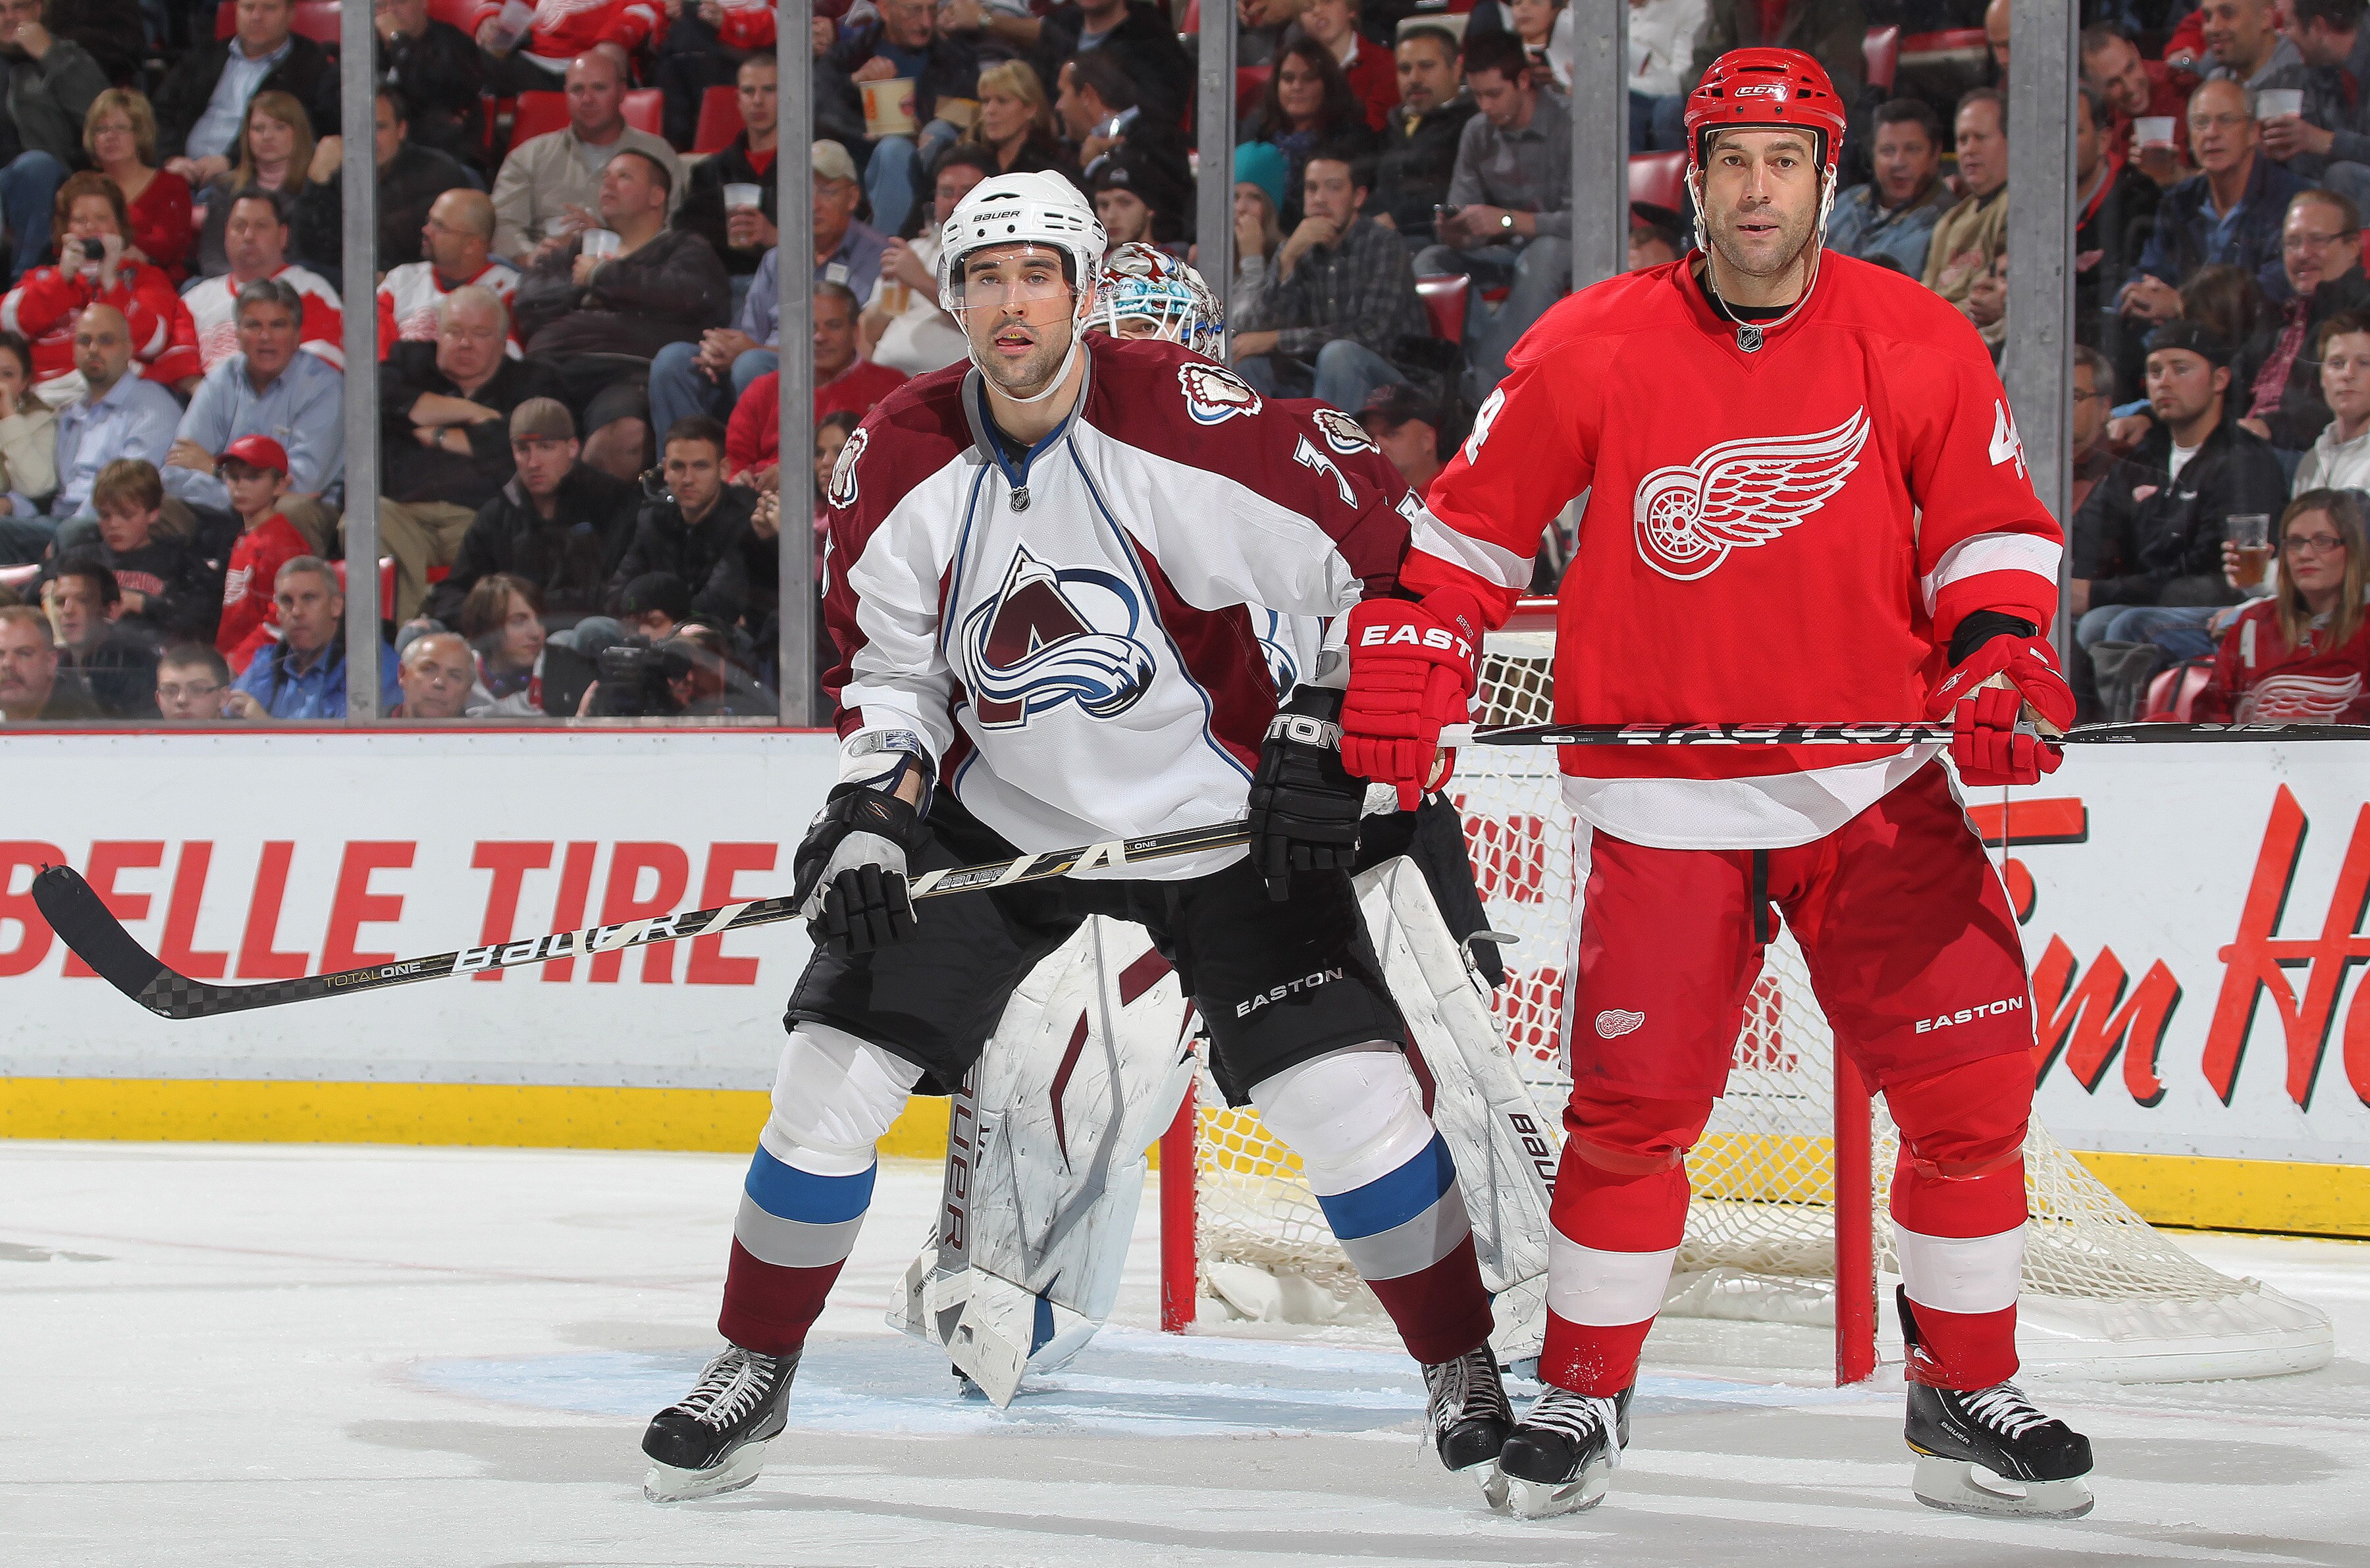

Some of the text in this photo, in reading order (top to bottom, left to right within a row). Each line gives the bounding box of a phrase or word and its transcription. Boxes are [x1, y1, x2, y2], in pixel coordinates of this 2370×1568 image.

[1739, 86, 1783, 96] CCM
[972, 210, 1021, 222] BAUER
[1261, 714, 1342, 752] TON
[470, 841, 778, 985] TIRE
[1236, 967, 1343, 1018] EASTON
[1915, 995, 2024, 1035] EASTON
[1941, 1421, 1970, 1445] BAUER
